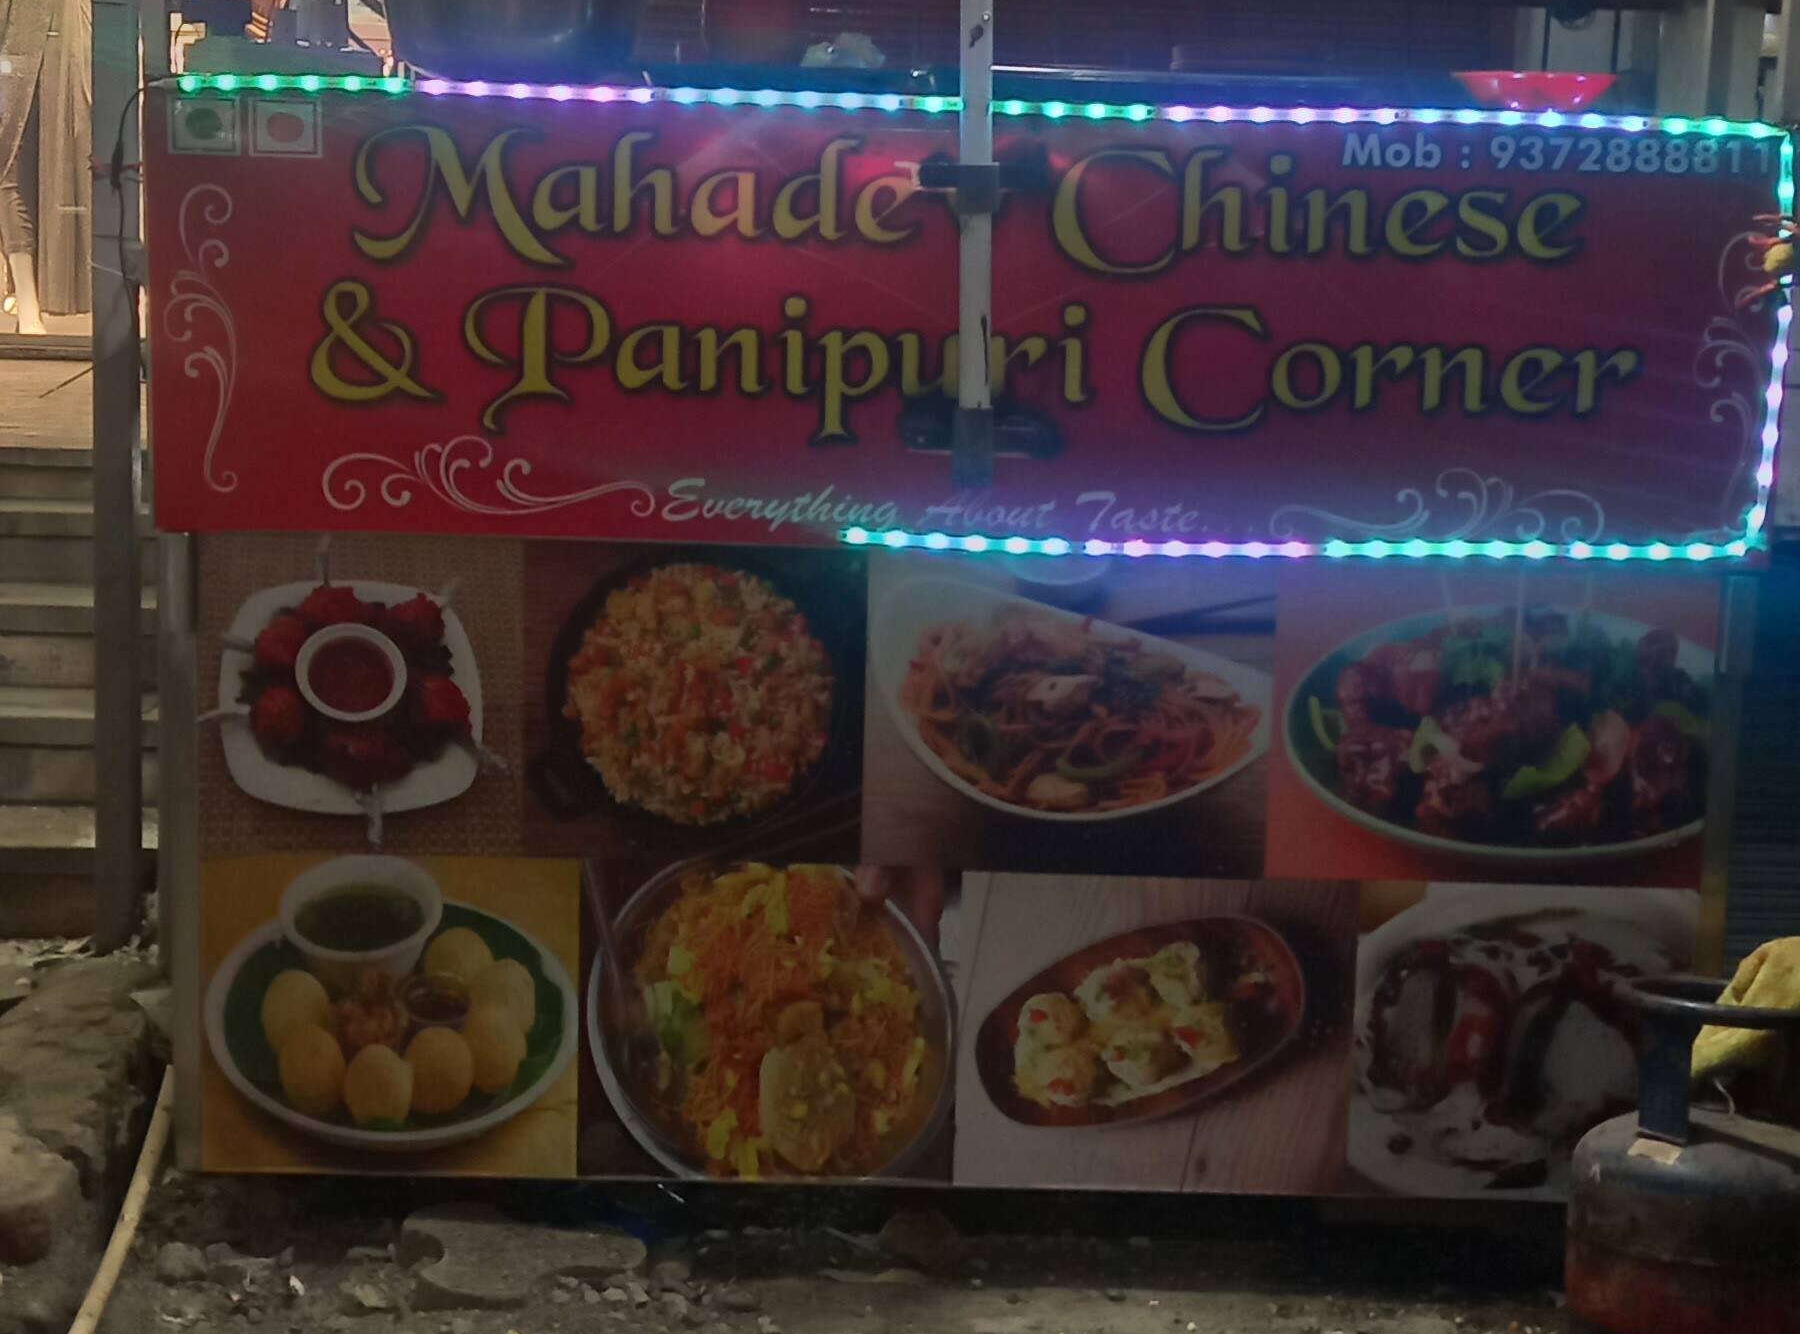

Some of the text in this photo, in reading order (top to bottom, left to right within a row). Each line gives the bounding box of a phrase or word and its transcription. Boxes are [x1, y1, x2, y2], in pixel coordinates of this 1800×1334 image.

[352, 125, 1582, 274] Mahade Chinese
[1342, 133, 1442, 168] Mob
[1490, 138, 1770, 175] 9372888811
[310, 280, 1640, 439] & Panipuri Corner
[662, 478, 898, 532] Everything
[916, 488, 1056, 529] About
